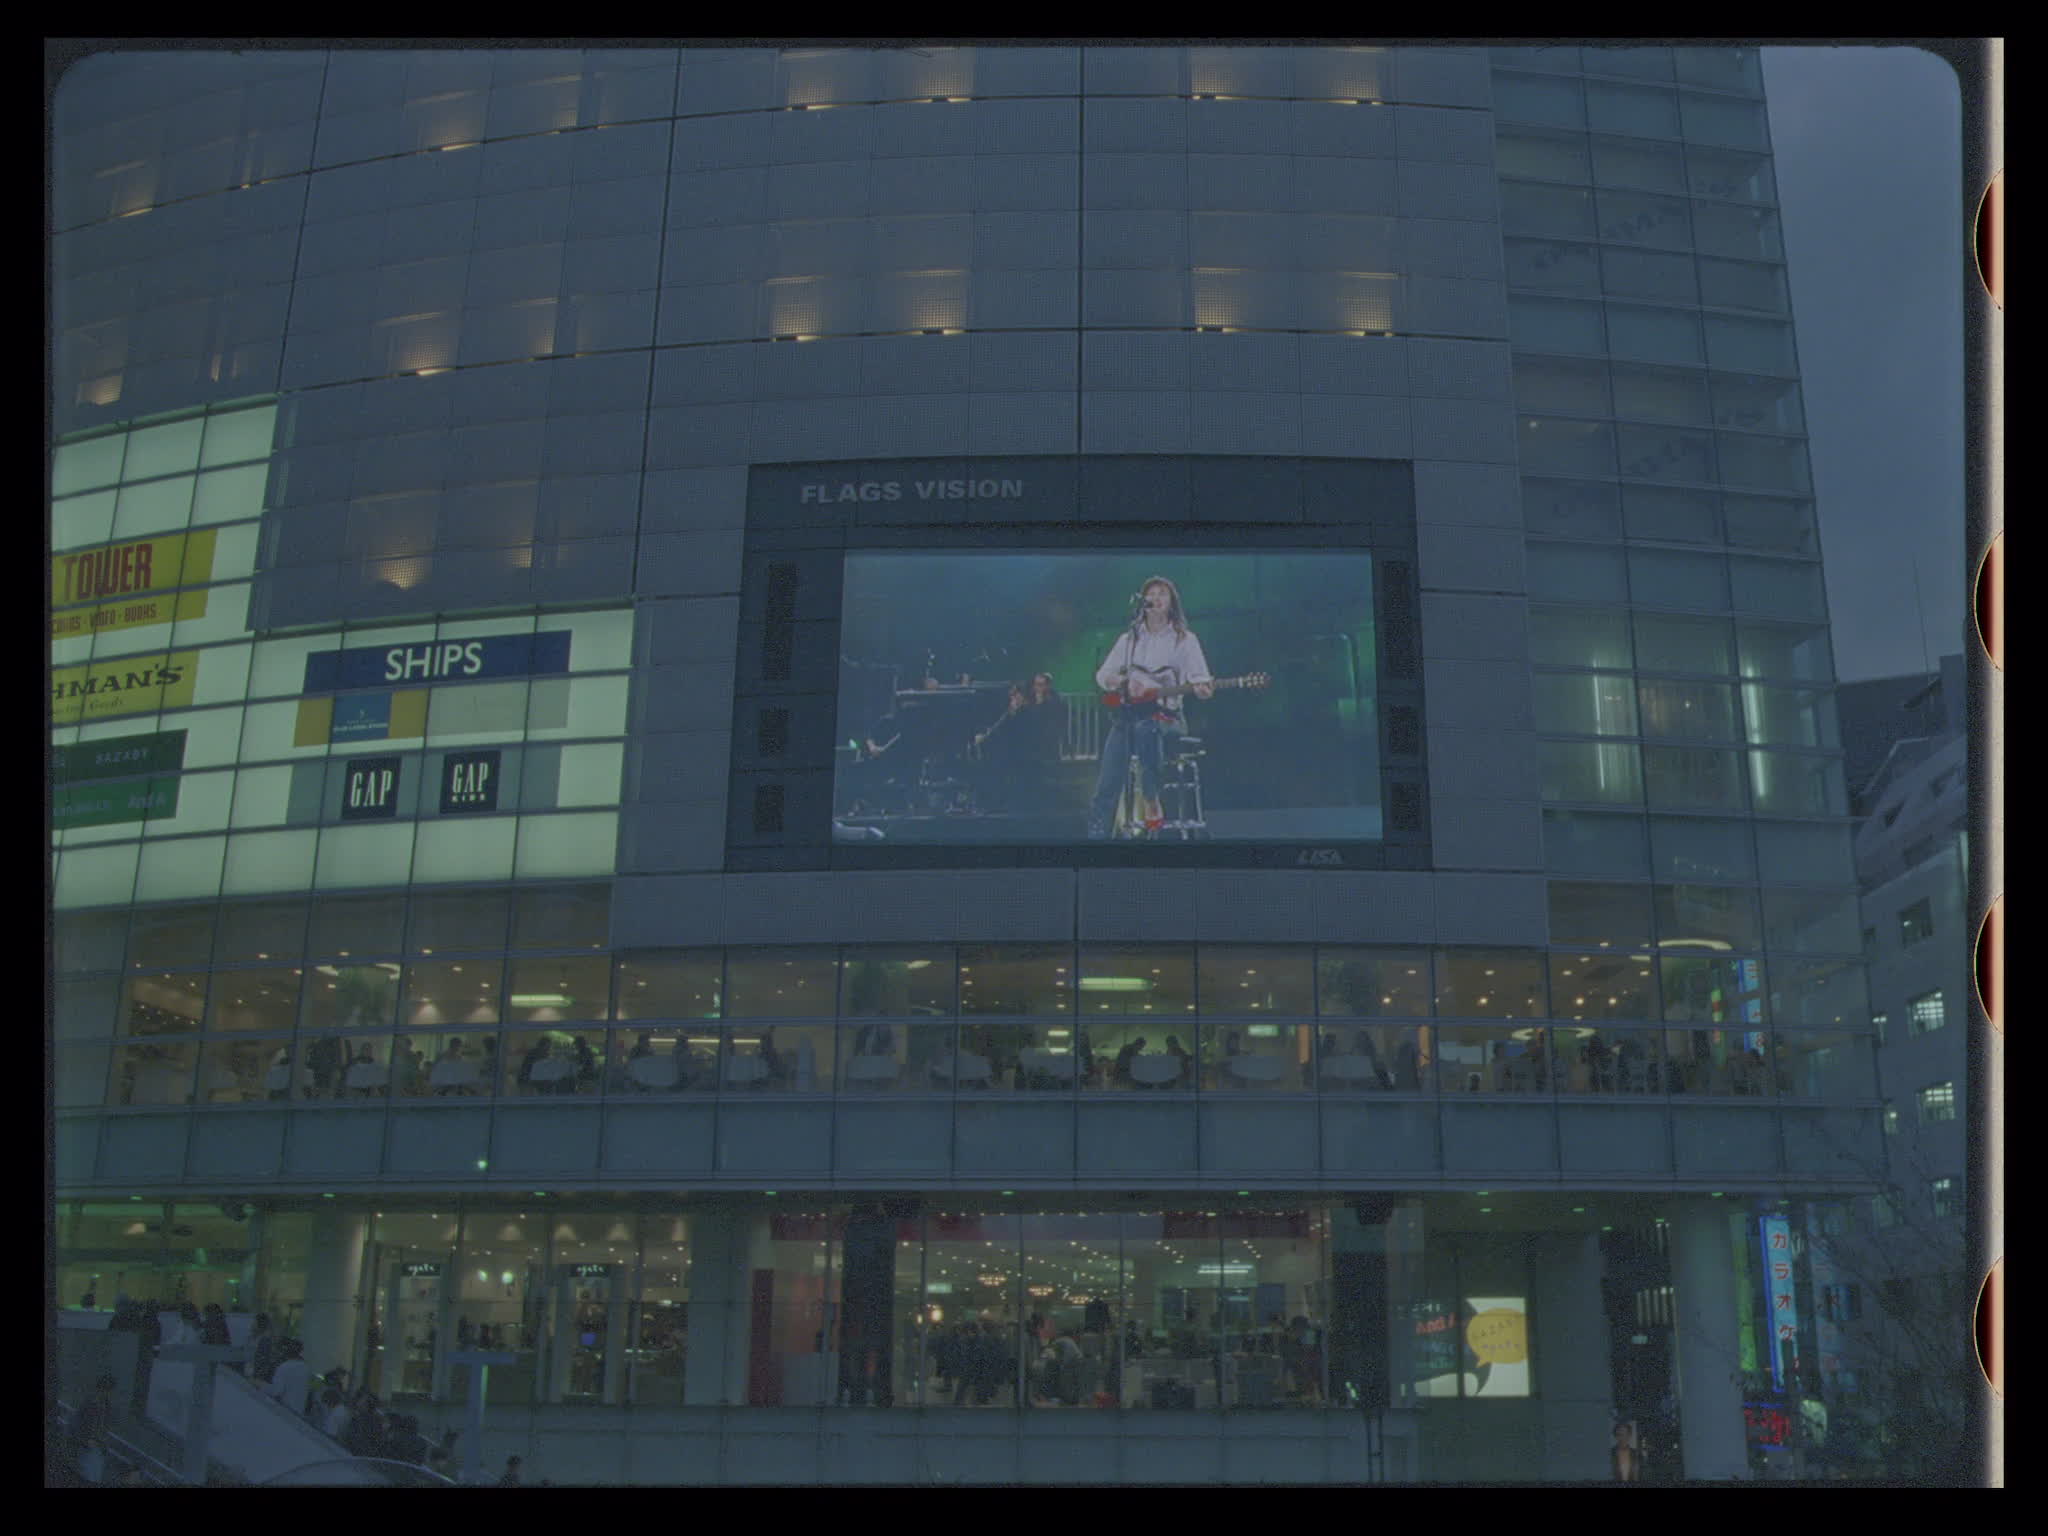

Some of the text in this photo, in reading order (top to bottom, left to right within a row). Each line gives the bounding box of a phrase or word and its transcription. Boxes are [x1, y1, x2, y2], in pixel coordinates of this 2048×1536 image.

[800, 478, 1023, 505] FLAGS VISION
[63, 542, 153, 603] TOWER
[385, 642, 482, 681] SHIPS
[350, 769, 393, 808] GAP
[451, 761, 489, 793] GAP
[1773, 1233, 1796, 1342] カラオケ
